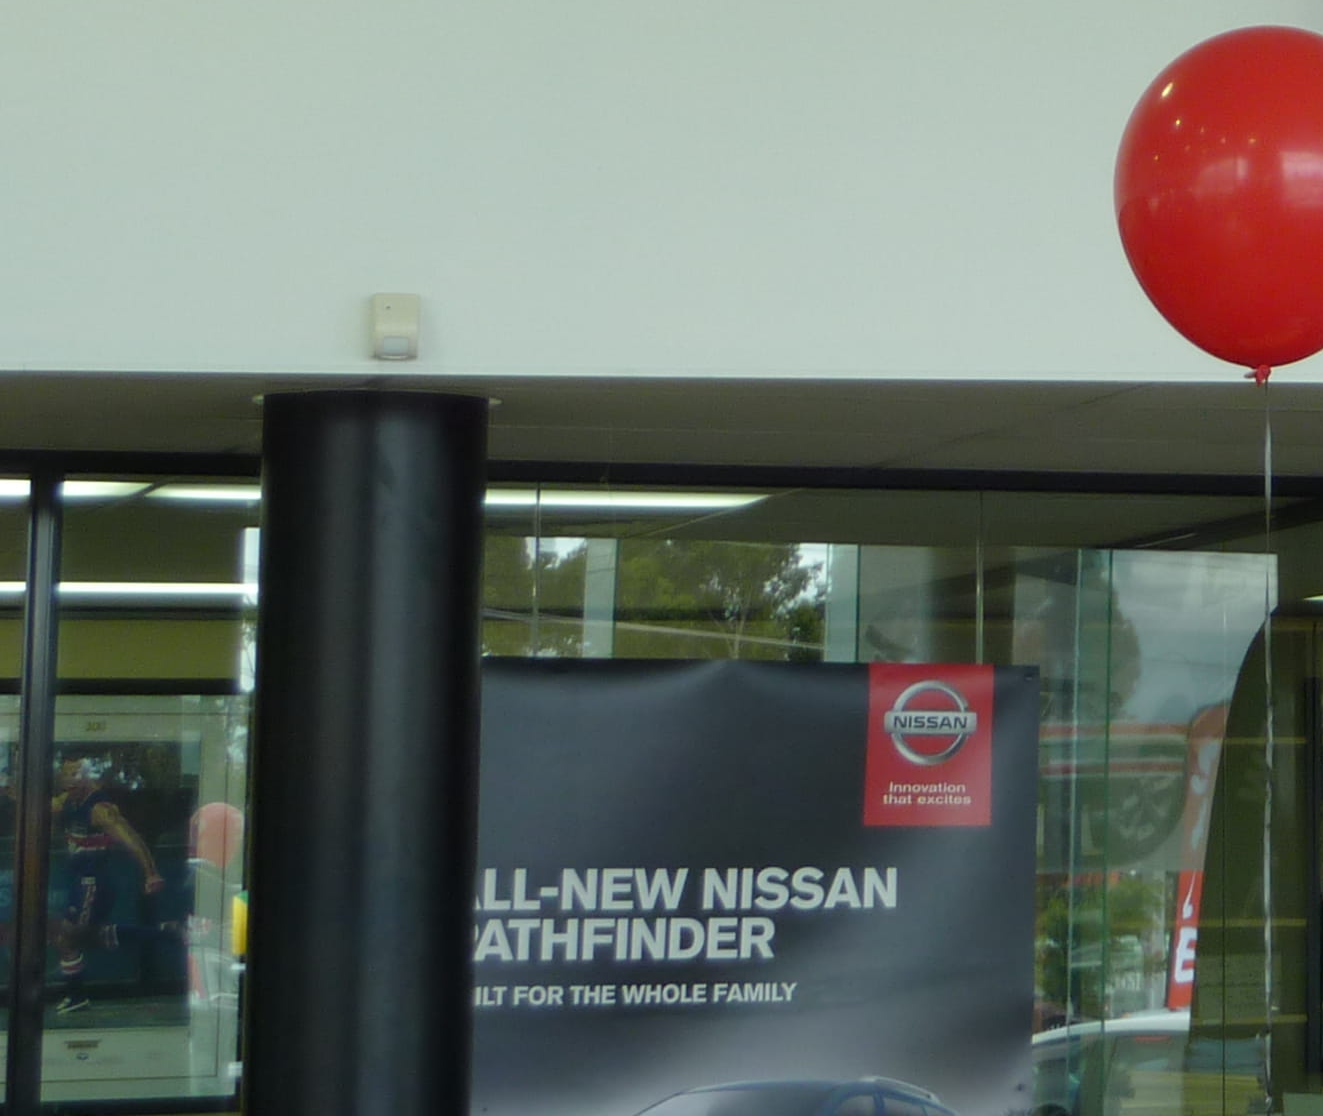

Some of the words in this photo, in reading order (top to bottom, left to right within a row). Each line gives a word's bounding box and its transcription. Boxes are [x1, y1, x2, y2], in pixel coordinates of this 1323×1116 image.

[893, 715, 968, 730] NISSAN
[889, 781, 966, 794] Innovation
[883, 794, 912, 805] that
[917, 794, 972, 805] excites
[475, 867, 690, 911] LL-NEW
[702, 866, 898, 910] NISSAN
[473, 917, 775, 962] ATHFINDER
[475, 985, 508, 1006] ILT
[513, 985, 563, 1006] FOR
[570, 985, 616, 1005] THE
[622, 983, 707, 1005] WHOLE
[712, 982, 797, 1003] FAMILY
